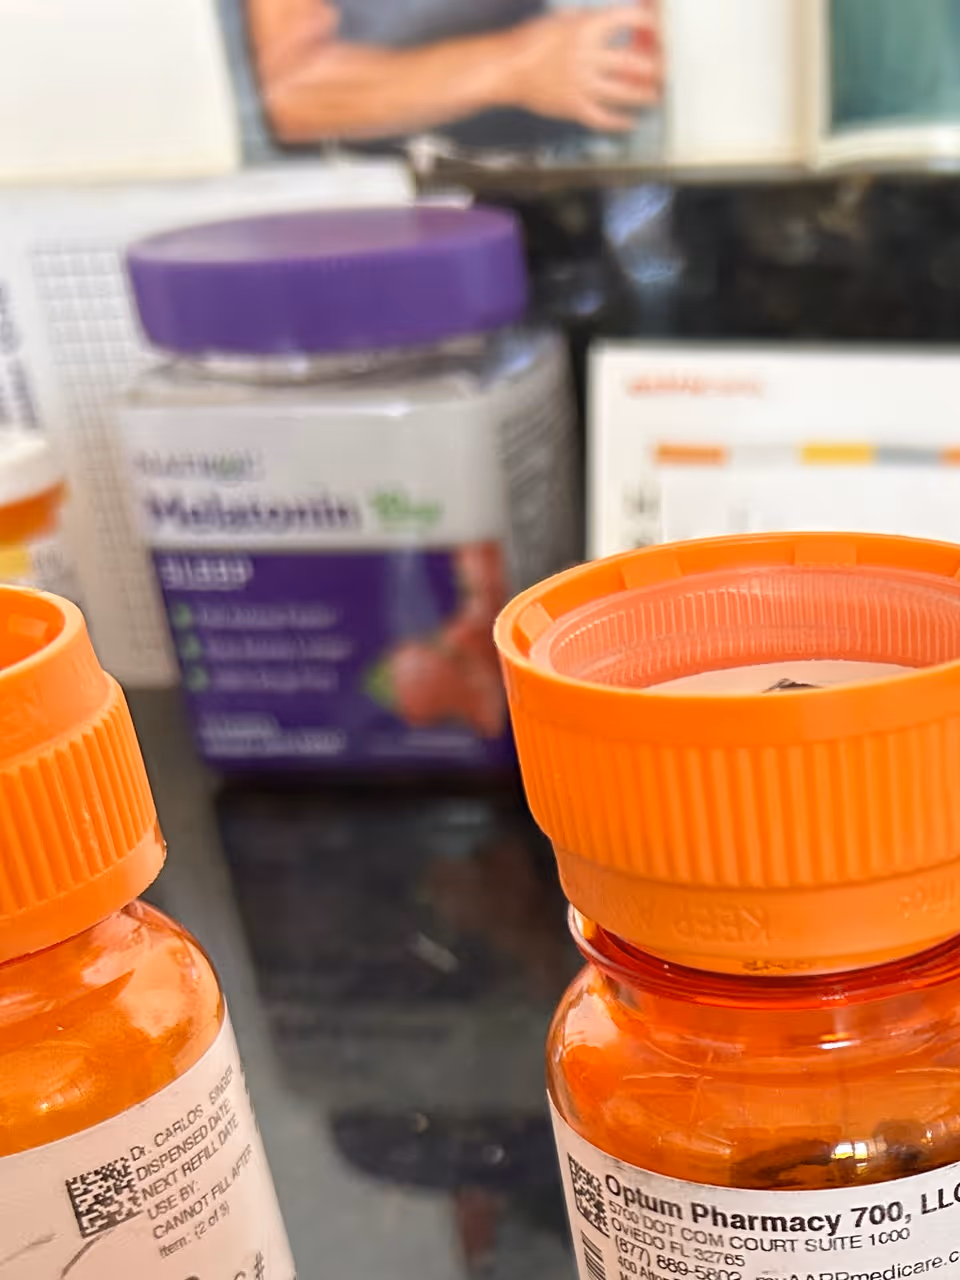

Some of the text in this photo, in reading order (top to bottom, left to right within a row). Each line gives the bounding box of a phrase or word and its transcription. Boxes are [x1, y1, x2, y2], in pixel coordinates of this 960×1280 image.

[150, 493, 361, 528] Melatonin
[136, 1098, 231, 1182] DISPENSED DATE
[154, 1103, 204, 1147] CARLOS
[142, 1113, 240, 1201] NEXT REFILL DATE
[147, 1180, 200, 1220] USE BY:
[153, 1195, 210, 1240] CANNOT
[211, 1176, 234, 1201] FILL
[605, 1174, 683, 1220] Optum
[691, 1202, 841, 1236] Pharmacy
[851, 1201, 912, 1225] 700,
[608, 1200, 910, 1252] 5700 DOT COM COURT SUITE 1000
[611, 1217, 746, 1268] OVIEDO FL 32765
[615, 1235, 651, 1267] (877)
